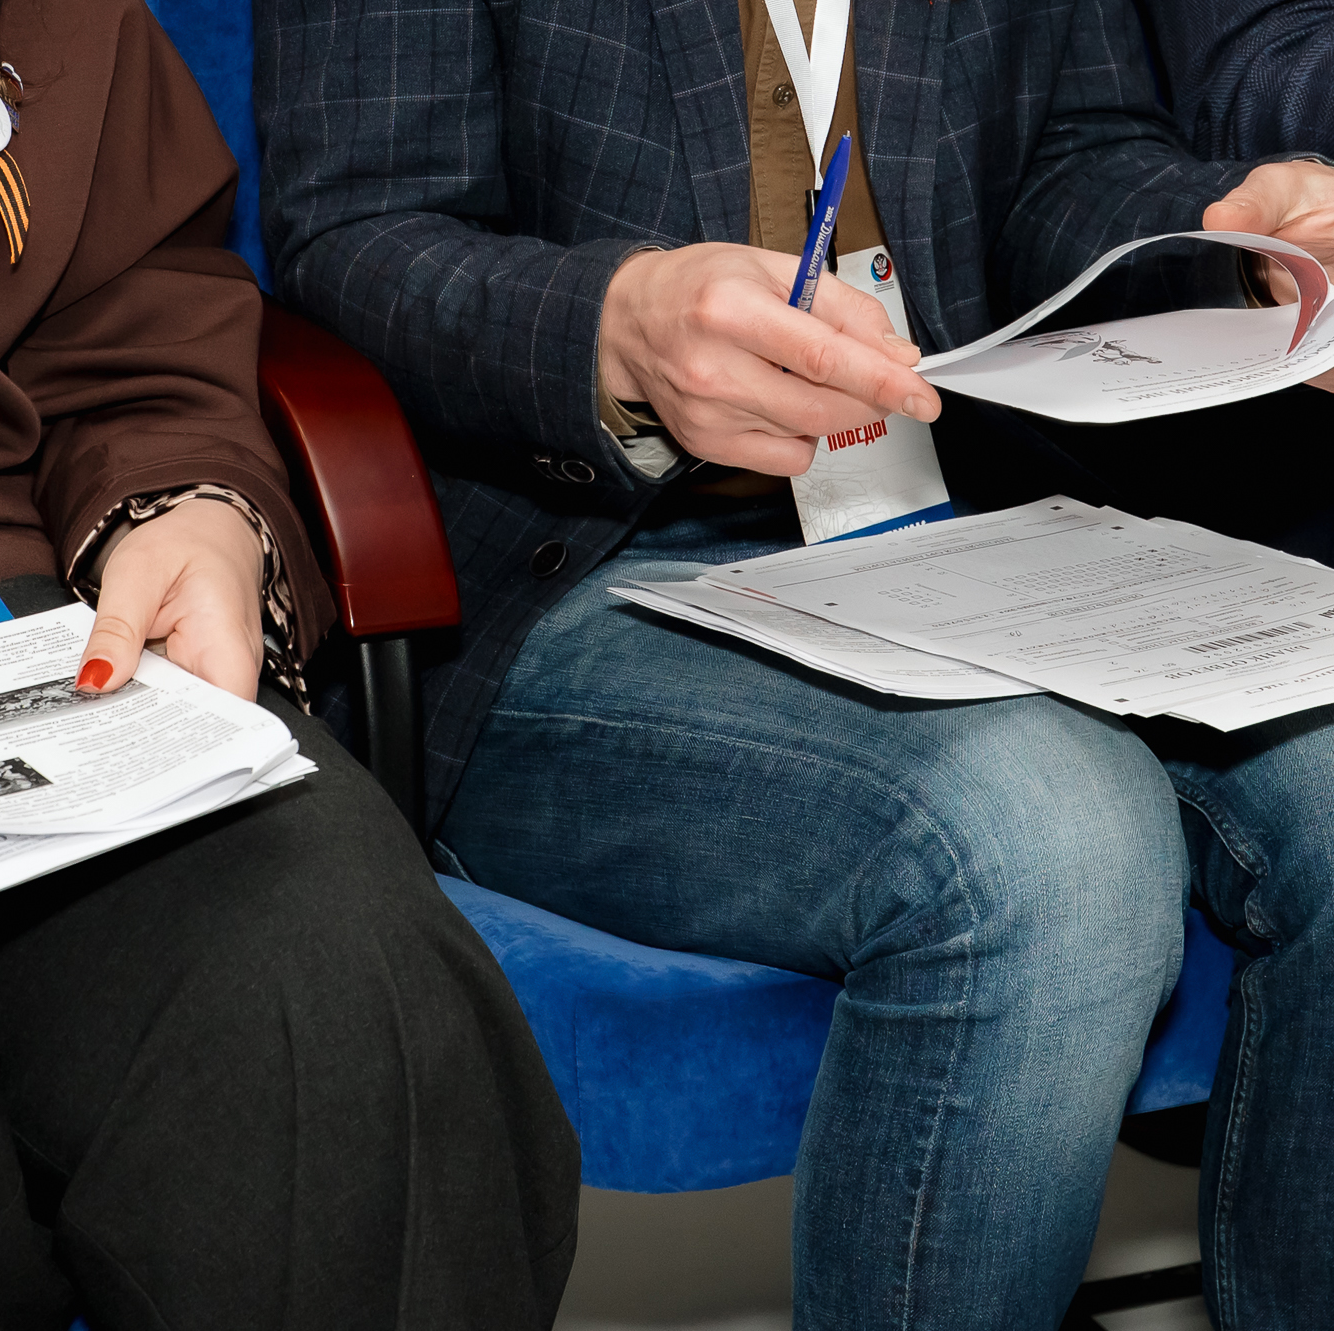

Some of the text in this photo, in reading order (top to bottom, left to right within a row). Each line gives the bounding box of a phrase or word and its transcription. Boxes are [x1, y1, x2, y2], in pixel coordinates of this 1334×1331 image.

[807, 222, 832, 278] Диктант
[1251, 644, 1311, 662] БЛАНК
[1163, 657, 1249, 681] ОТВЕТОВ
